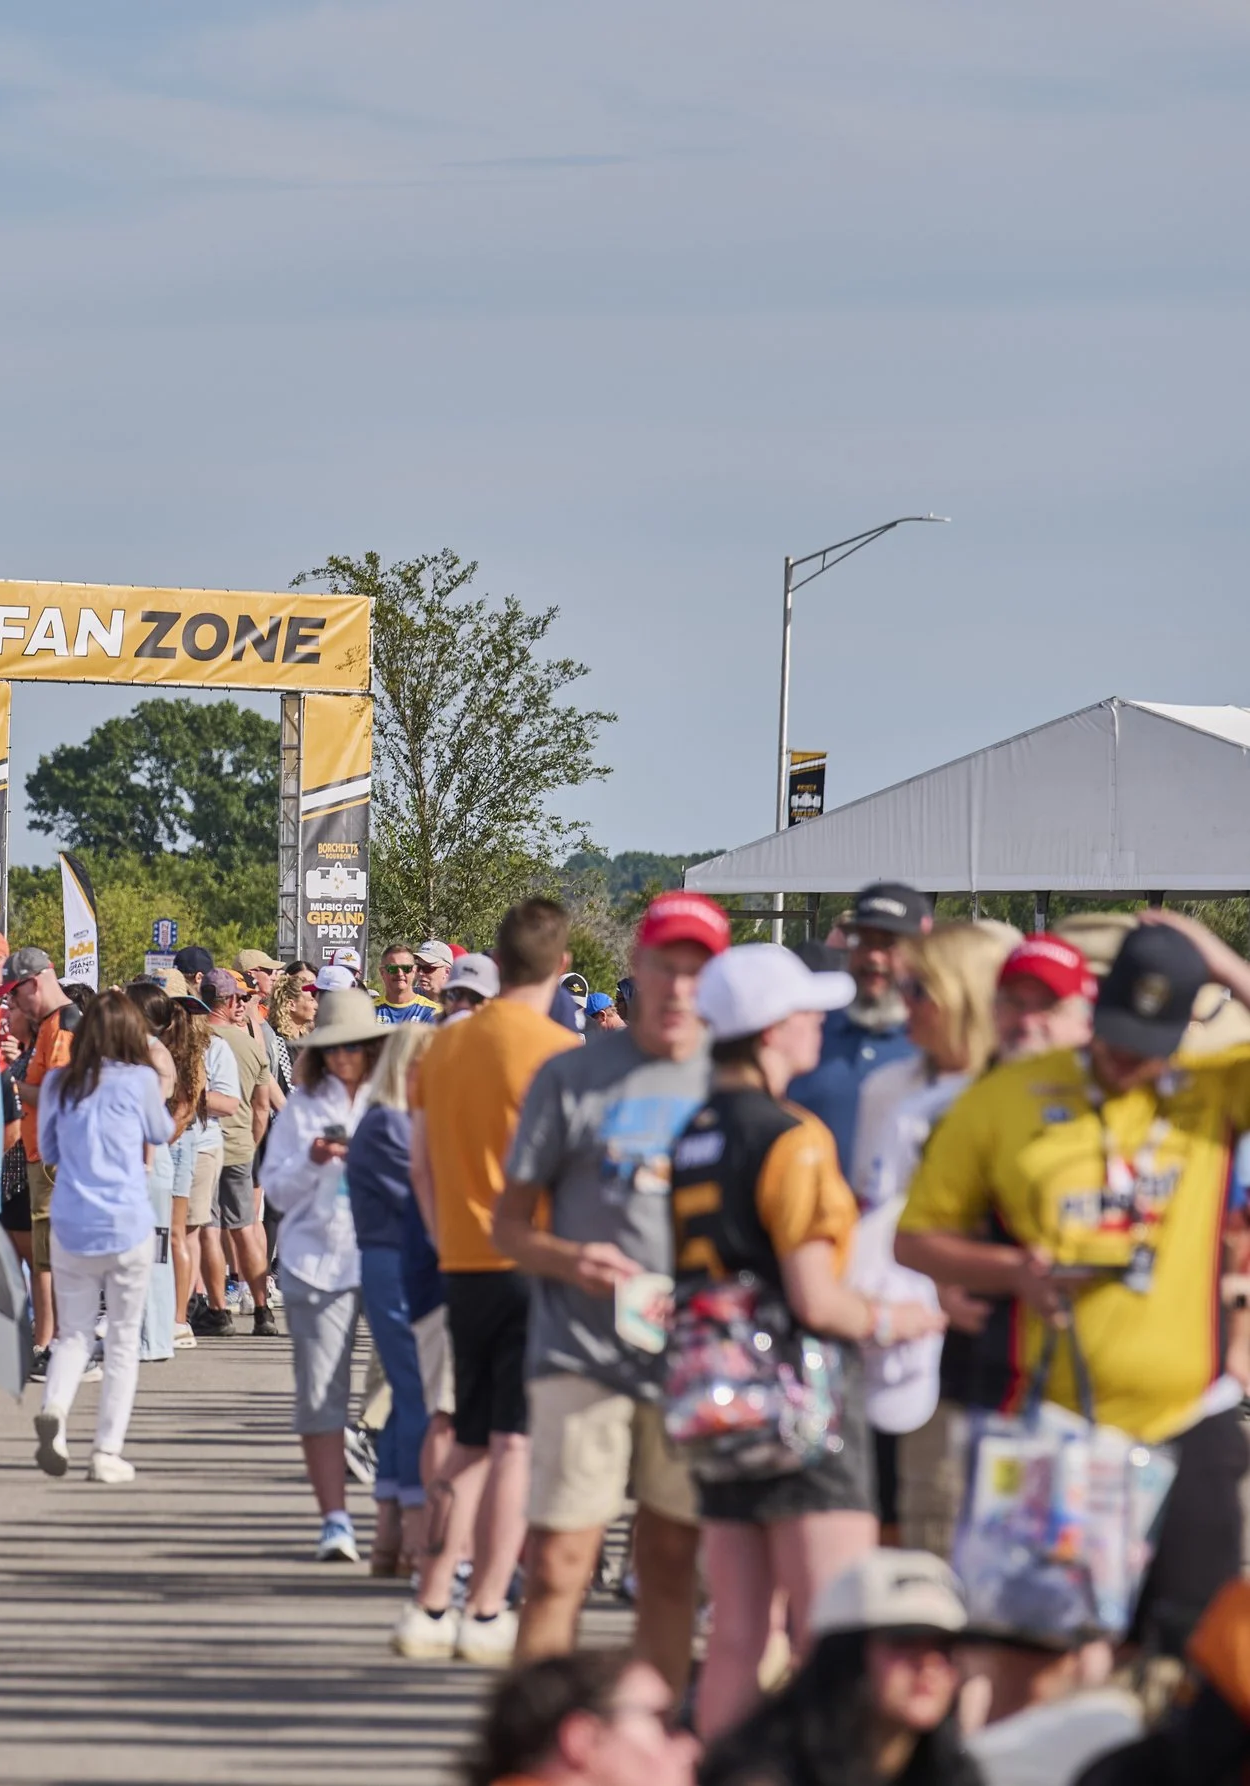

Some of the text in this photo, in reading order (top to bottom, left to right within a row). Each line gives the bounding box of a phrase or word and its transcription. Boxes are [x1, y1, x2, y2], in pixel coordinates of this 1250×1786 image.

[134, 611, 326, 664] ZONE
[318, 843, 359, 855] BORCHETTA
[310, 902, 364, 912] MUSIC CITY
[307, 911, 365, 925] GRAND
[317, 925, 359, 939] PRIX
